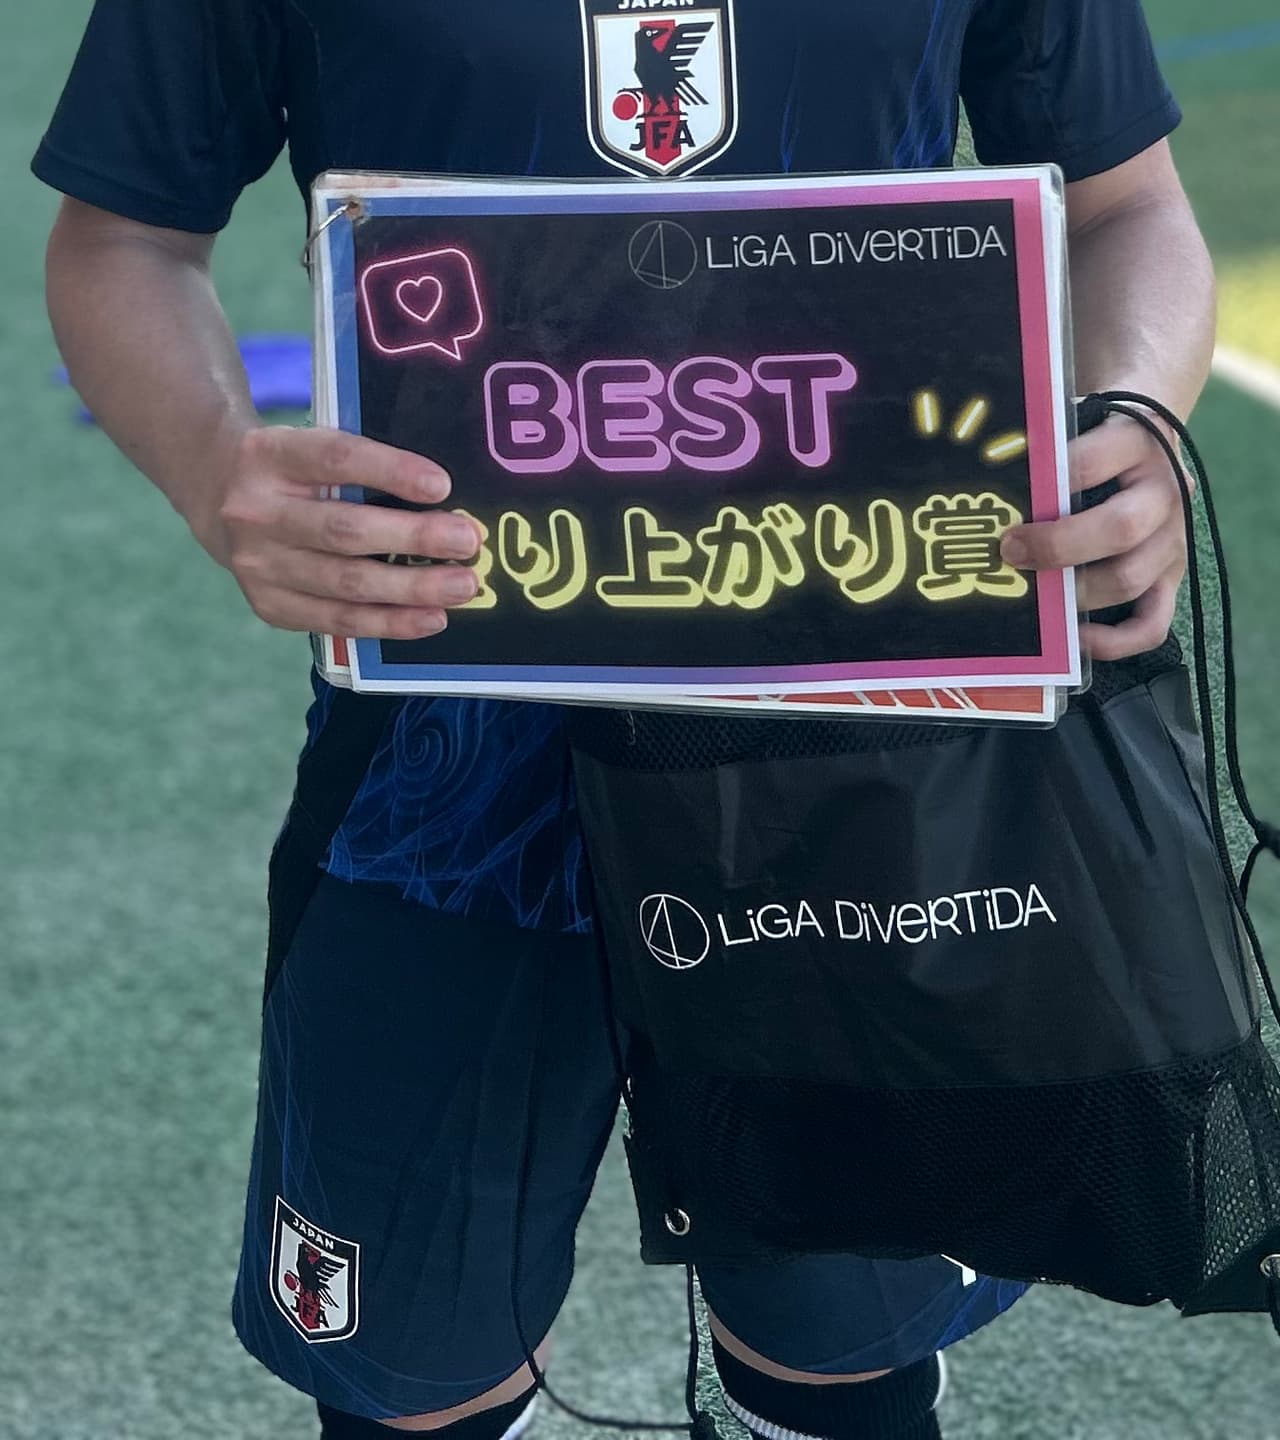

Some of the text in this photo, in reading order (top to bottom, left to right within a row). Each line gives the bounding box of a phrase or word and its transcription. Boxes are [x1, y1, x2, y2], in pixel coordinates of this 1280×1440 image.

[629, 120, 696, 151] JFA
[483, 352, 858, 474] BEST
[388, 491, 1029, 610] り上がり賞
[292, 1216, 335, 1251] JAPAN
